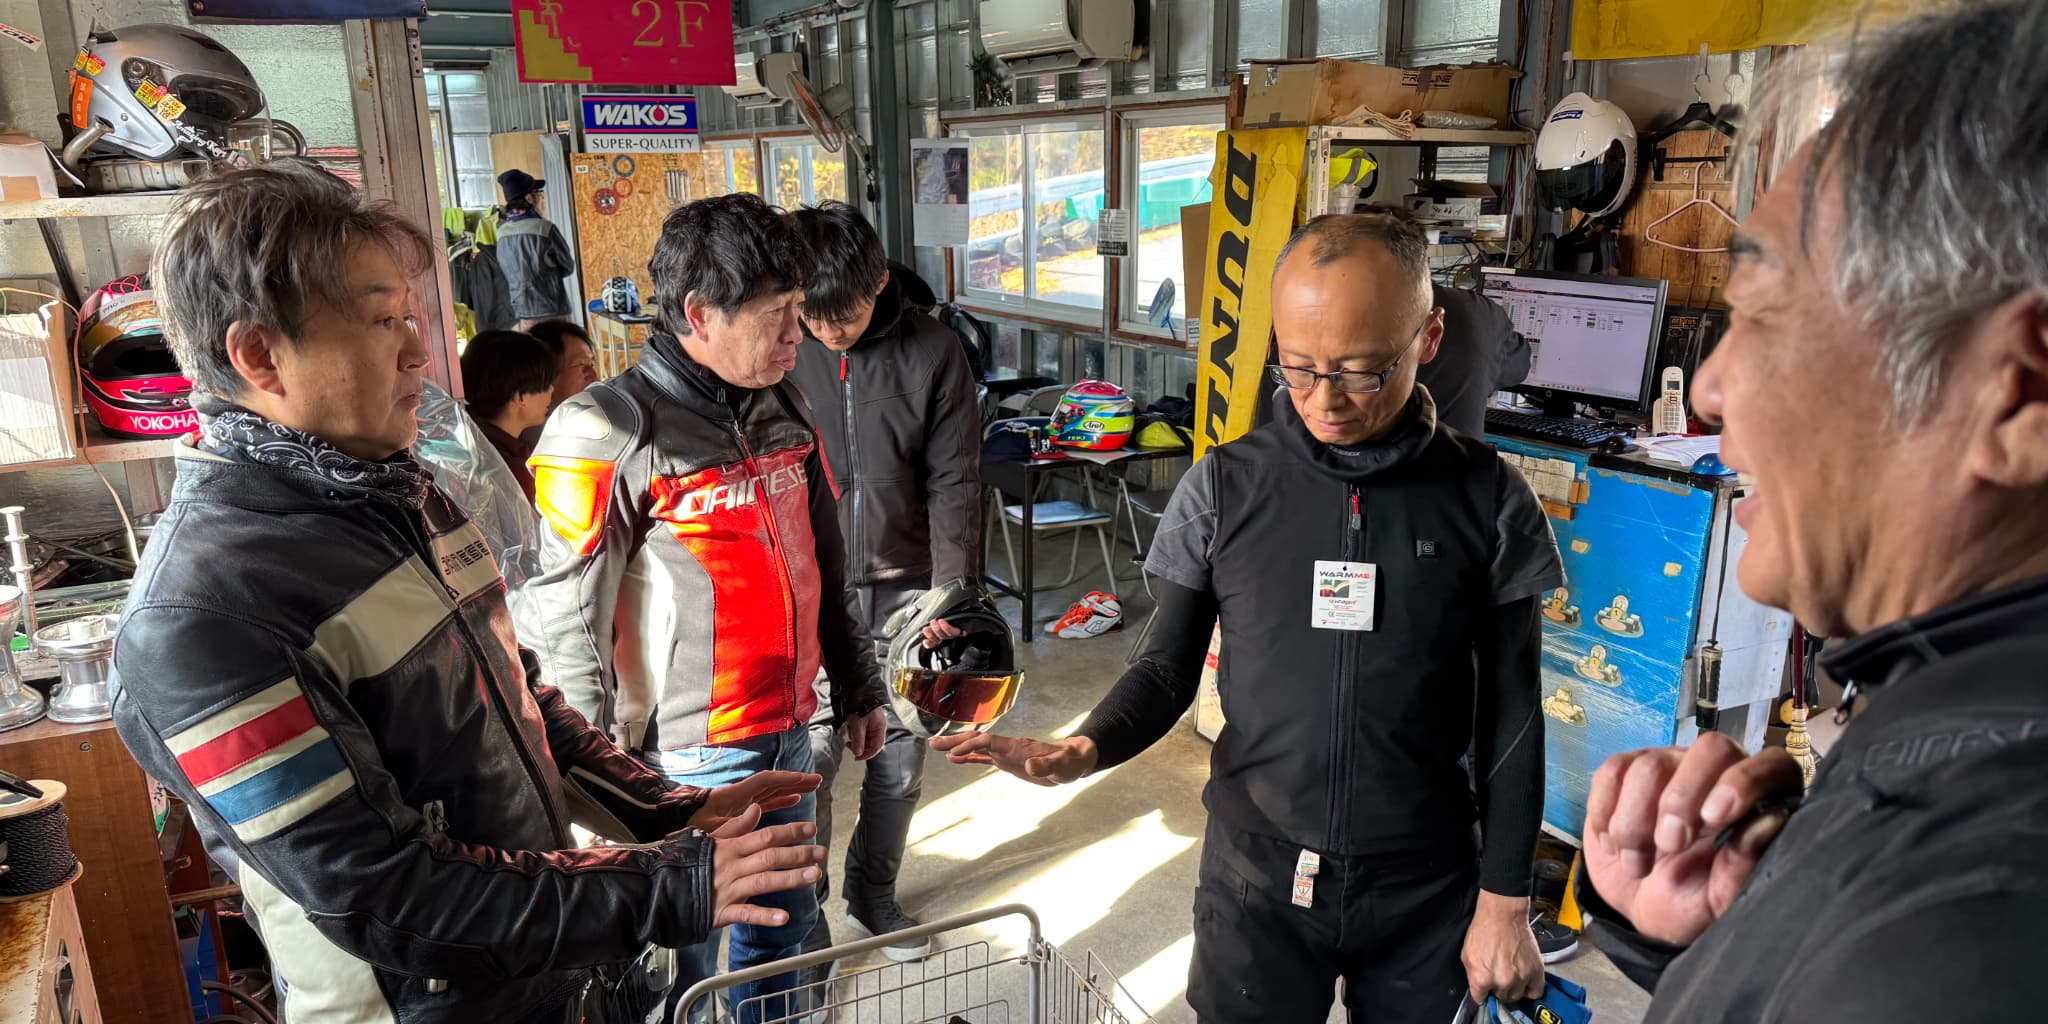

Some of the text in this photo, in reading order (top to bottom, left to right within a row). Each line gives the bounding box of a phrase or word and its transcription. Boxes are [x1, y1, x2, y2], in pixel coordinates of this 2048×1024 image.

[630, 0, 711, 48] 2F
[593, 103, 688, 127] WAKO'S
[592, 138, 695, 151] SUPER-QUALITY
[1205, 133, 1257, 452] DUNL
[1319, 570, 1371, 579] WARMME
